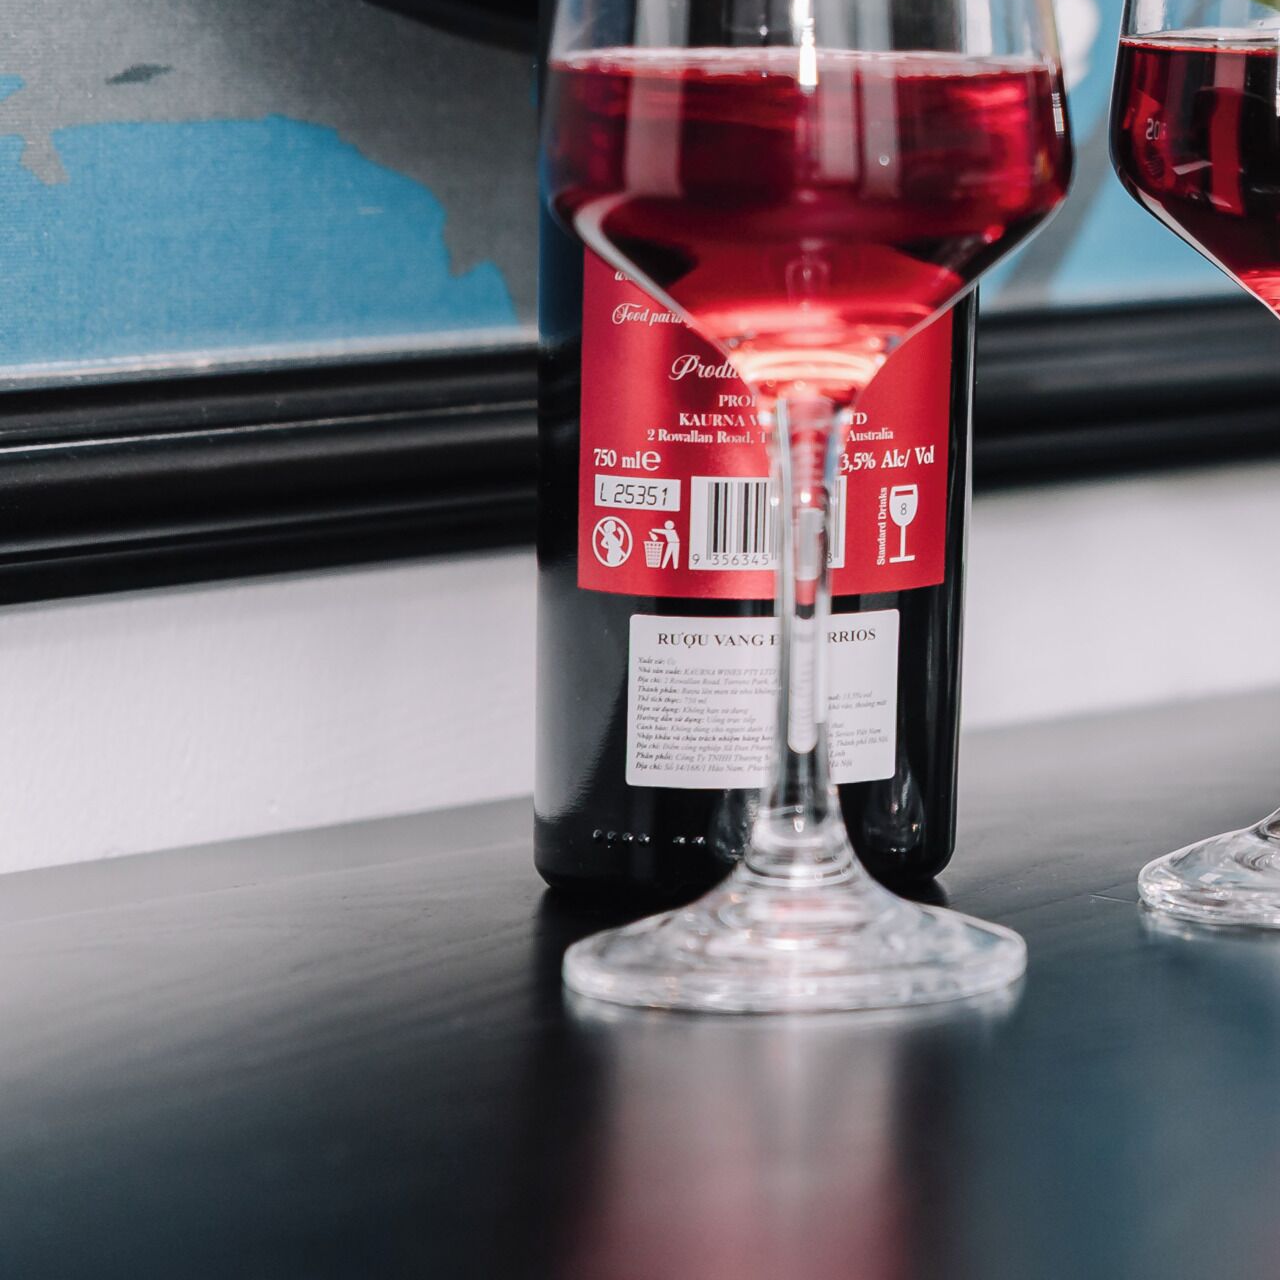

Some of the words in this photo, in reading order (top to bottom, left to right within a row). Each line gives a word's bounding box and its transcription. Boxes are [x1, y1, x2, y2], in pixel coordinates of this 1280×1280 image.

[612, 303, 650, 325] Food
[668, 354, 740, 381] Produ
[679, 412, 745, 427] KAURNA
[647, 429, 655, 441] 2
[657, 429, 713, 444] Rowallan
[716, 431, 755, 444] Road,
[847, 427, 894, 442] Australia
[593, 448, 617, 468] 750
[839, 451, 877, 472] 3,5%
[880, 449, 911, 469] Alc/
[914, 444, 935, 465] Vol
[600, 482, 607, 502] L
[613, 483, 669, 507] 25351
[877, 487, 888, 519] Drinks
[900, 502, 908, 516] 8
[876, 520, 887, 566] Standard
[691, 553, 700, 566] 9
[714, 634, 764, 647] VANG
[827, 628, 876, 644] RRIOS
